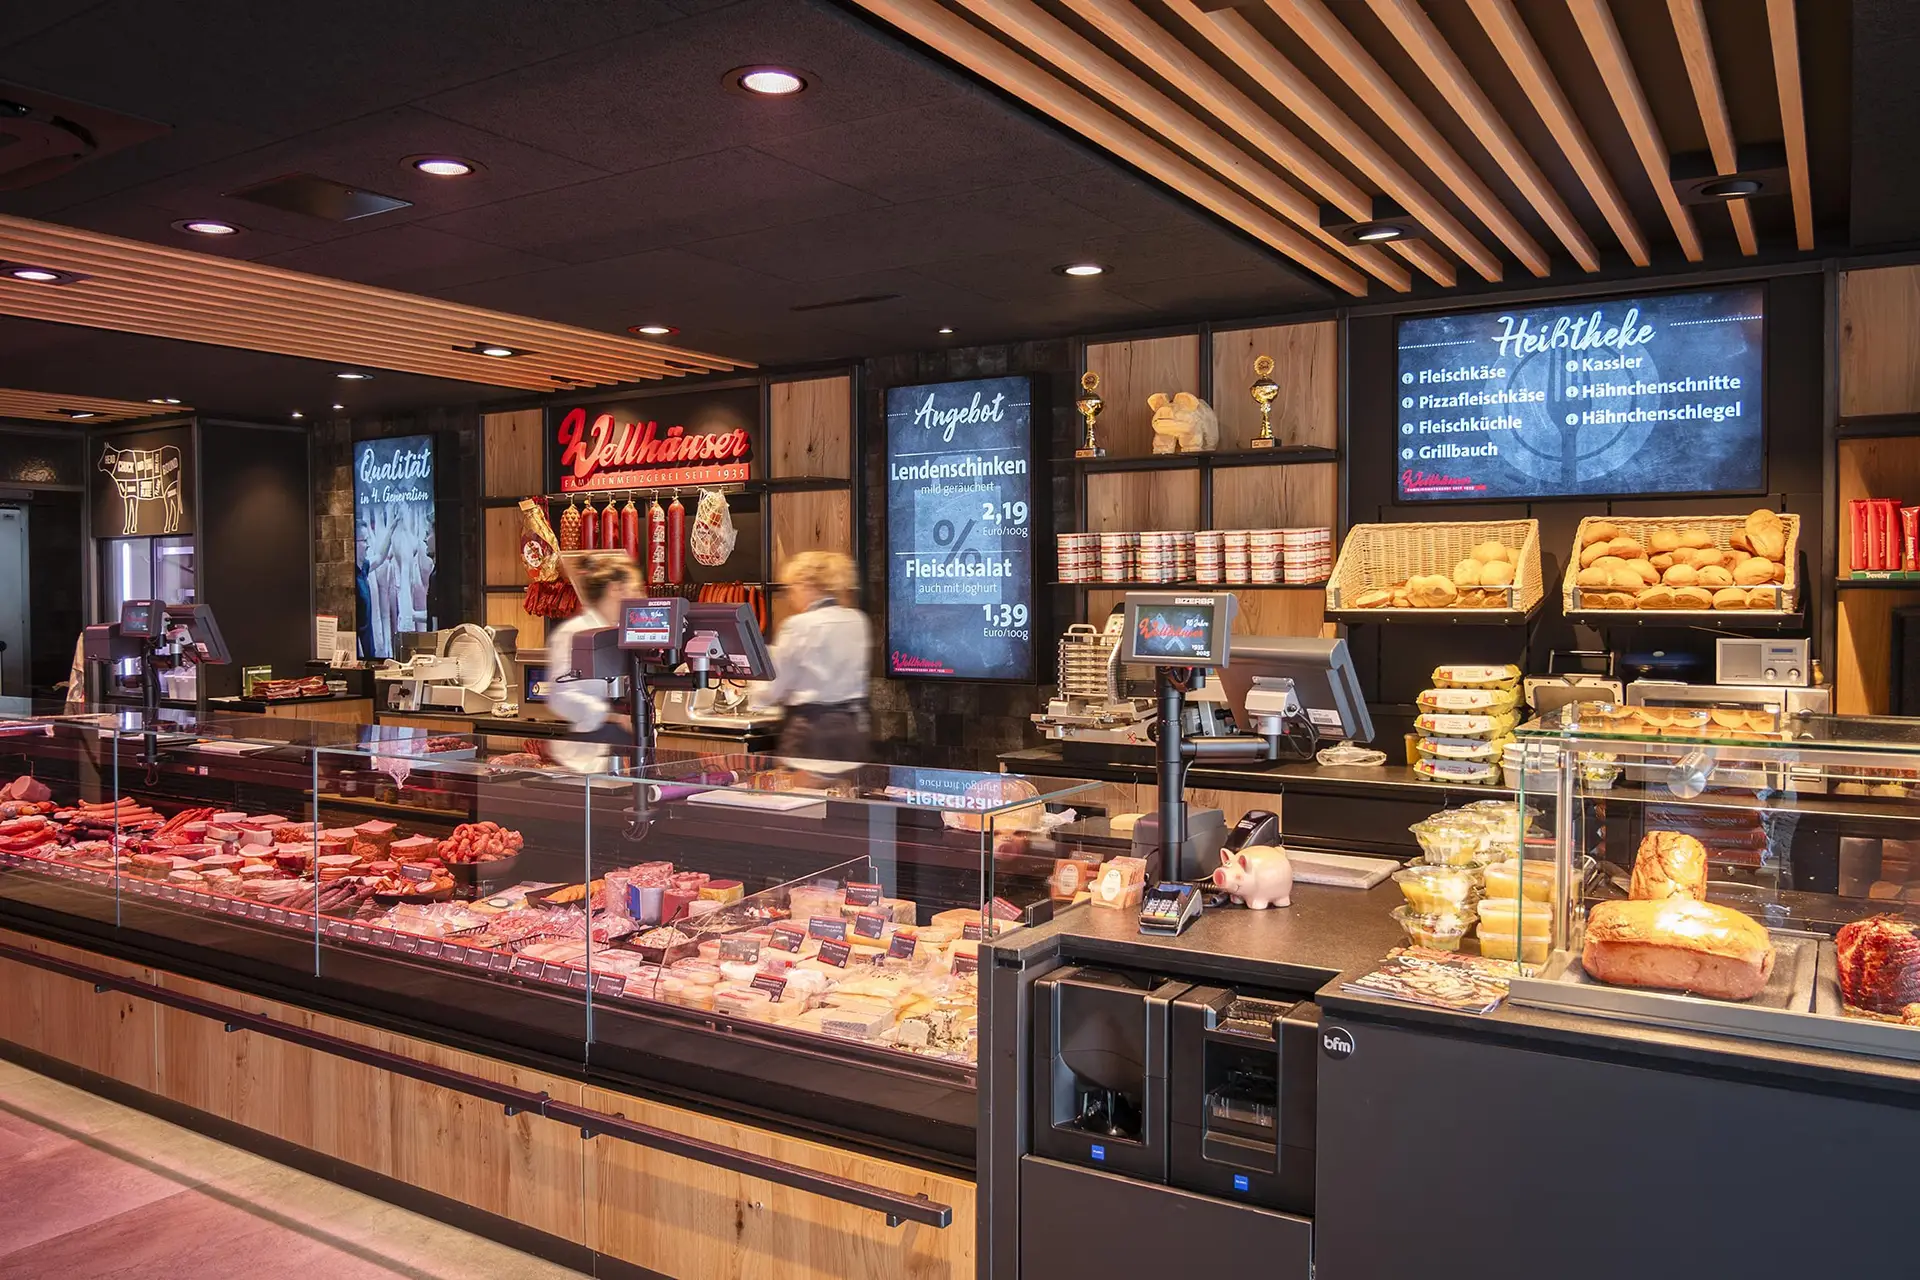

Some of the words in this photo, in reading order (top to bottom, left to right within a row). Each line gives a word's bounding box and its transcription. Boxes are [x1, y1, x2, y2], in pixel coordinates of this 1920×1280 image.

[1491, 307, 1656, 358] Heißtheke
[1582, 355, 1643, 373] Kassler
[1419, 365, 1506, 386] Fleischkäse
[1582, 375, 1741, 399] Hähnchenschnitte
[1419, 388, 1545, 409] Pizzafleischkäse
[914, 391, 1005, 442] Angebot
[1582, 401, 1741, 426] Hähnchenschlegel
[1419, 415, 1523, 434] Fleischküchle
[558, 407, 750, 478] Wellhäuser
[1419, 442, 1498, 460] Grillbauch
[360, 448, 431, 484] Qualität
[686, 470, 711, 480] SEIT
[717, 468, 745, 480] 1935
[891, 456, 1027, 481] Lendenschinken
[360, 492, 369, 505] in
[371, 487, 380, 503] 4.
[382, 485, 429, 503] Generation
[921, 484, 941, 495] mild
[943, 481, 995, 496] geräuchert
[982, 501, 1028, 525] 2,19
[983, 525, 1028, 537] Euro/100g
[906, 557, 1012, 578] Fleischsalat
[919, 583, 942, 594] auch
[943, 582, 960, 593] mit
[961, 581, 998, 596] Joghurt
[983, 603, 1028, 628] 1,39
[983, 627, 1029, 640] Euro/100g
[1323, 1035, 1351, 1053] bfm
